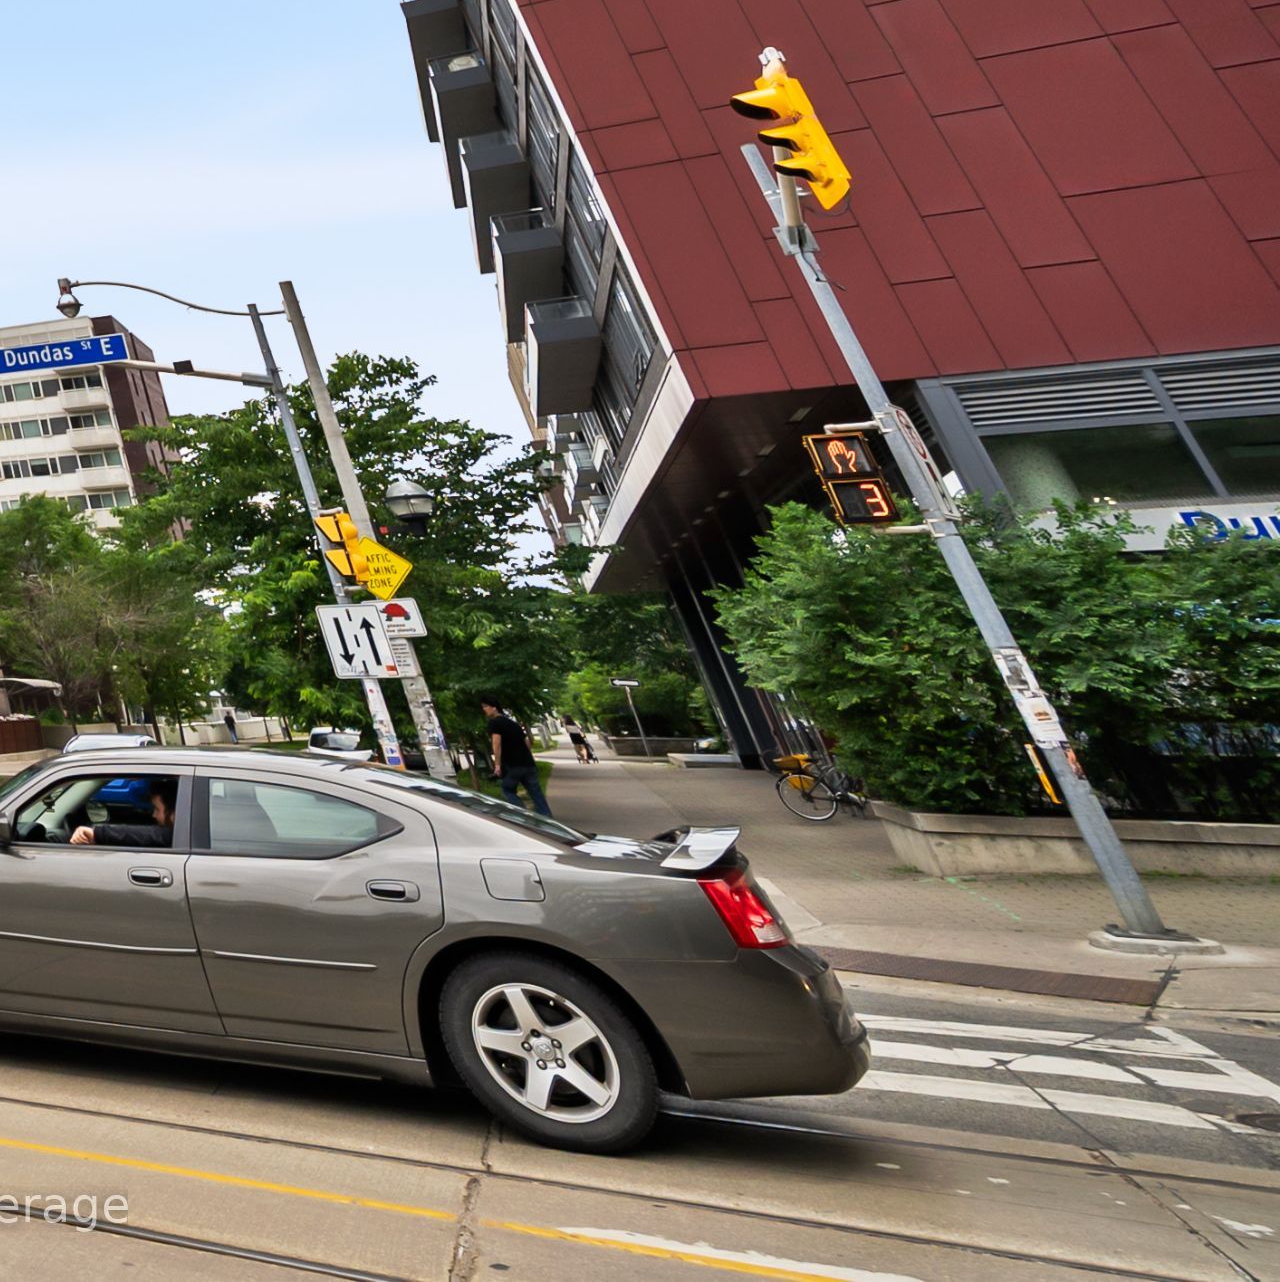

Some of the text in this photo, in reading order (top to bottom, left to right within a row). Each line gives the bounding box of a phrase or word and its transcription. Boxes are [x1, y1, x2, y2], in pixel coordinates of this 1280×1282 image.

[3, 337, 114, 367] Dundas St E
[860, 483, 889, 517] 3
[1180, 511, 1280, 542] Du
[366, 553, 391, 563] AFFIC
[368, 565, 397, 576] LMING
[370, 577, 393, 589] ZONE
